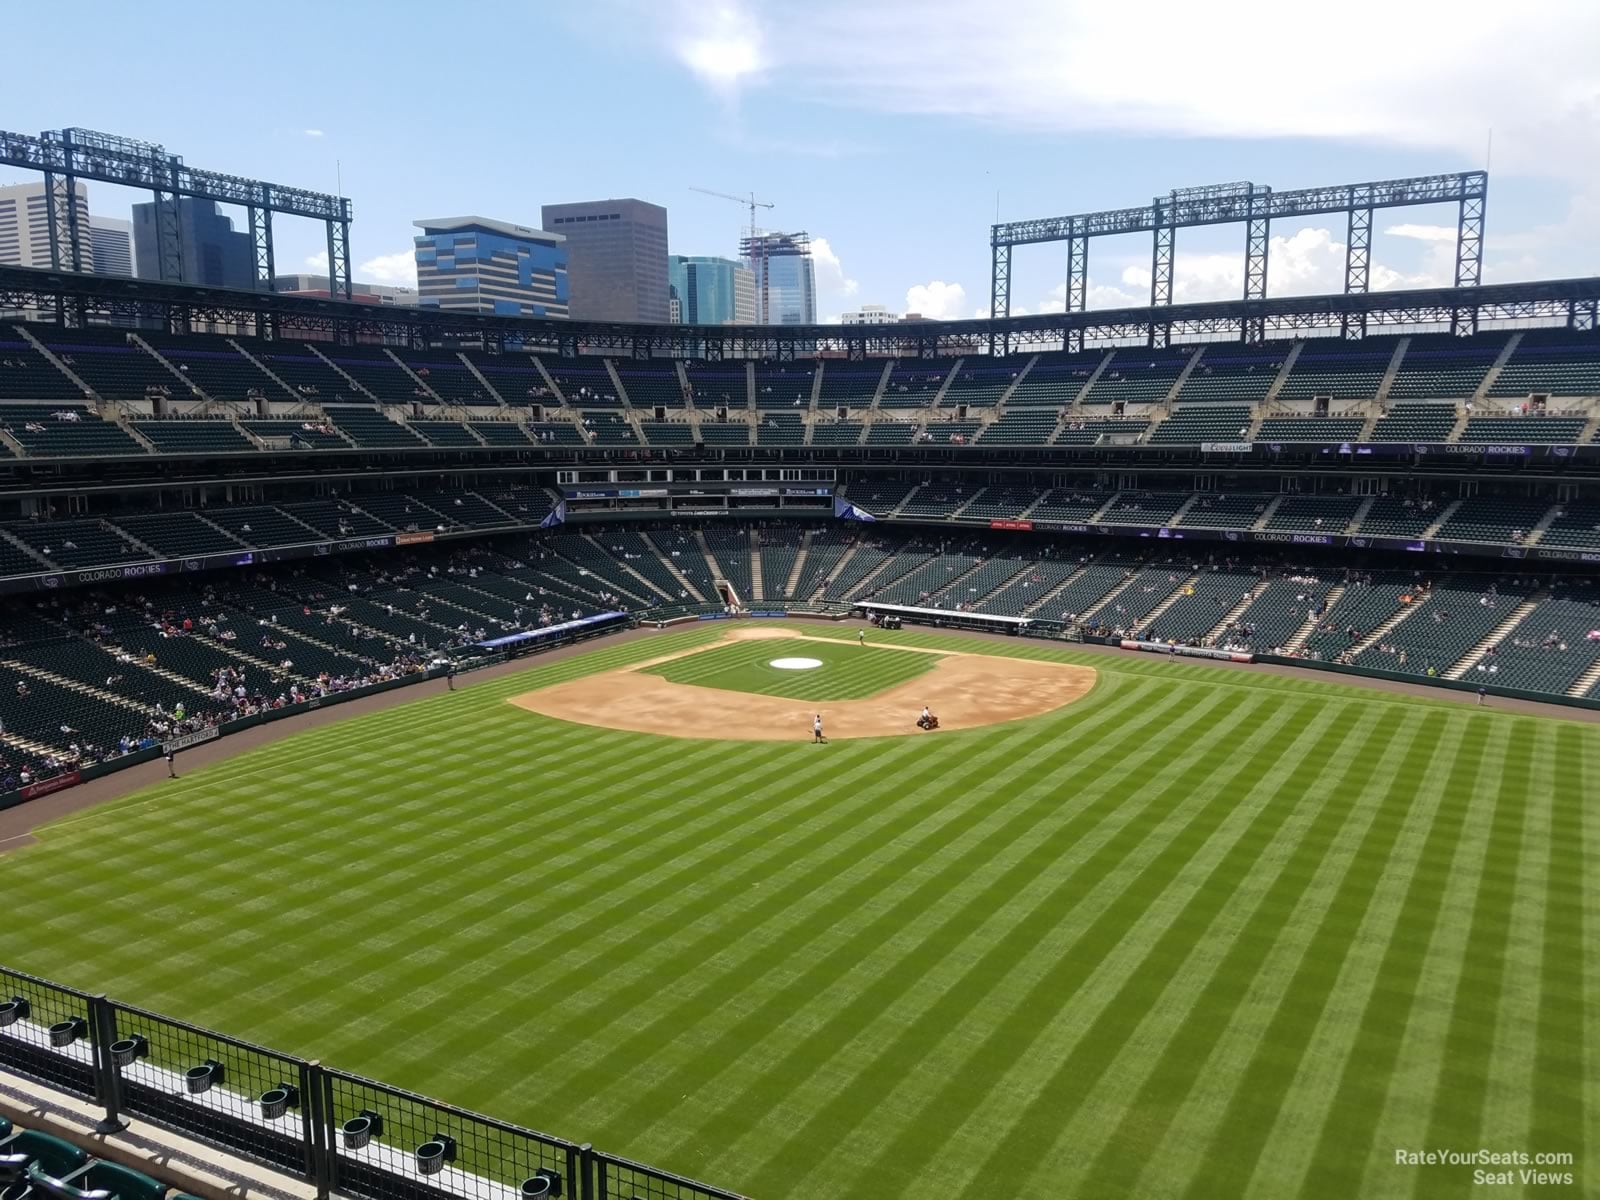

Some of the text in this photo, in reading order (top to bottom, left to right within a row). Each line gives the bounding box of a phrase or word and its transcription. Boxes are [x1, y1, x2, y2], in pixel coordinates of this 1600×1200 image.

[1446, 445, 1526, 455] COLORADO ROCKIES
[1063, 524, 1088, 532] ROCKIES
[1254, 533, 1328, 544] COLORADO ROCKIES
[338, 541, 366, 551] COLORADO
[366, 538, 390, 548] ROCKIES
[1538, 550, 1579, 560] COLORADO
[79, 564, 161, 582] COLORADO ROCKIES
[181, 729, 214, 746] HARTFORD
